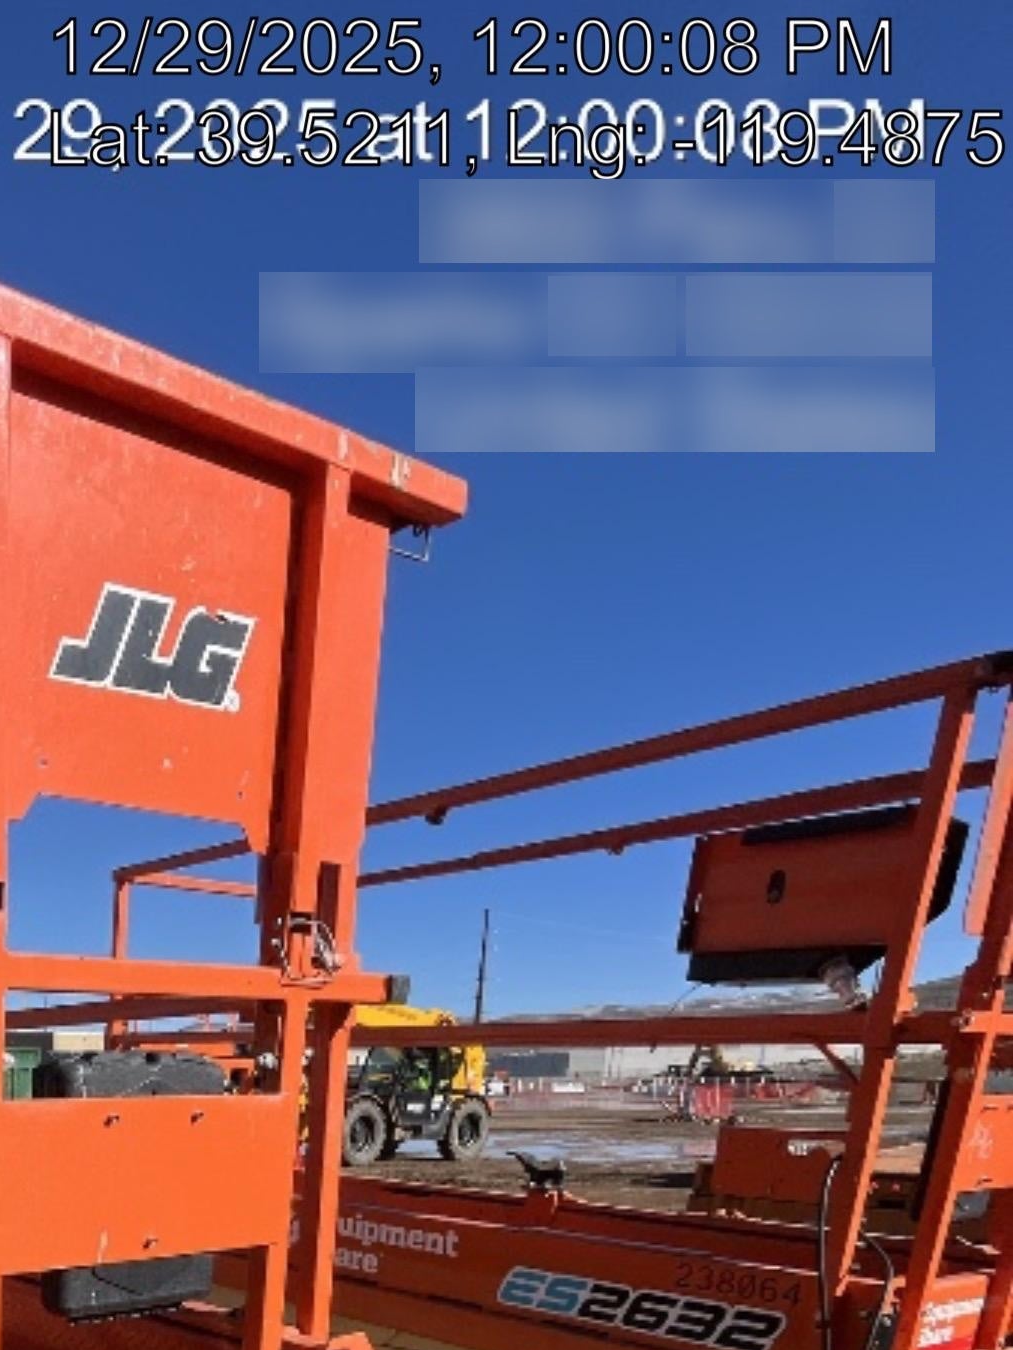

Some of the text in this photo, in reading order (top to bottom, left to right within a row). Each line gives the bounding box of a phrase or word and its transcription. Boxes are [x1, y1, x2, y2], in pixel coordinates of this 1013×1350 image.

[48, 581, 257, 710] JLG
[337, 1214, 459, 1258] uipment
[334, 1248, 378, 1273] are
